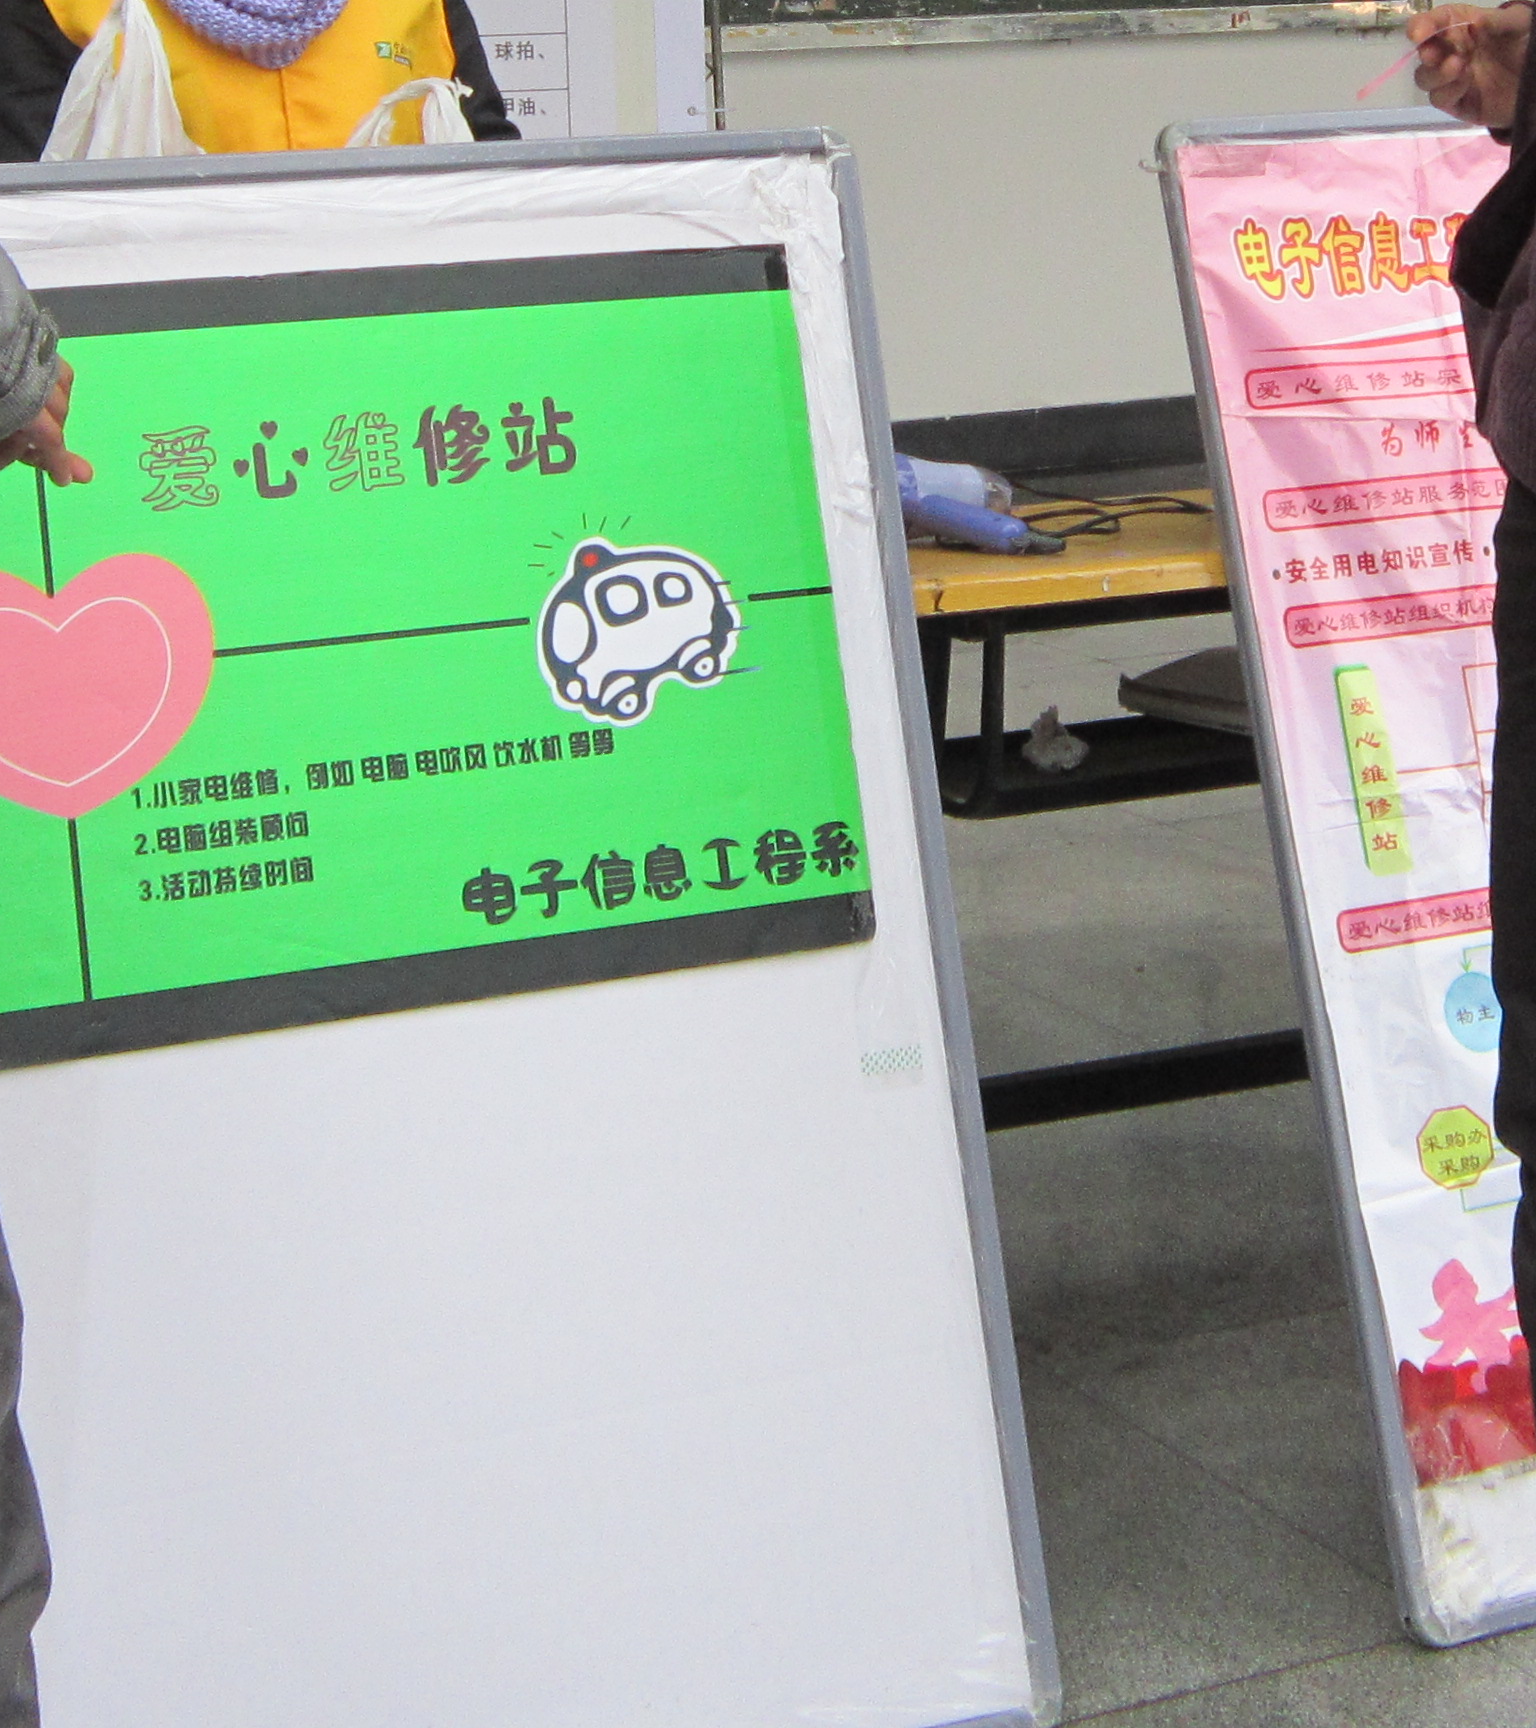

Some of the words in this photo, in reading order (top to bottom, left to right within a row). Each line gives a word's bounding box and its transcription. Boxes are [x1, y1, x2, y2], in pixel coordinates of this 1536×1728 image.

[139, 398, 578, 513] 爱心维修站
[1349, 697, 1398, 852] 爱心维修站
[462, 822, 860, 925] 电子信息工程系
